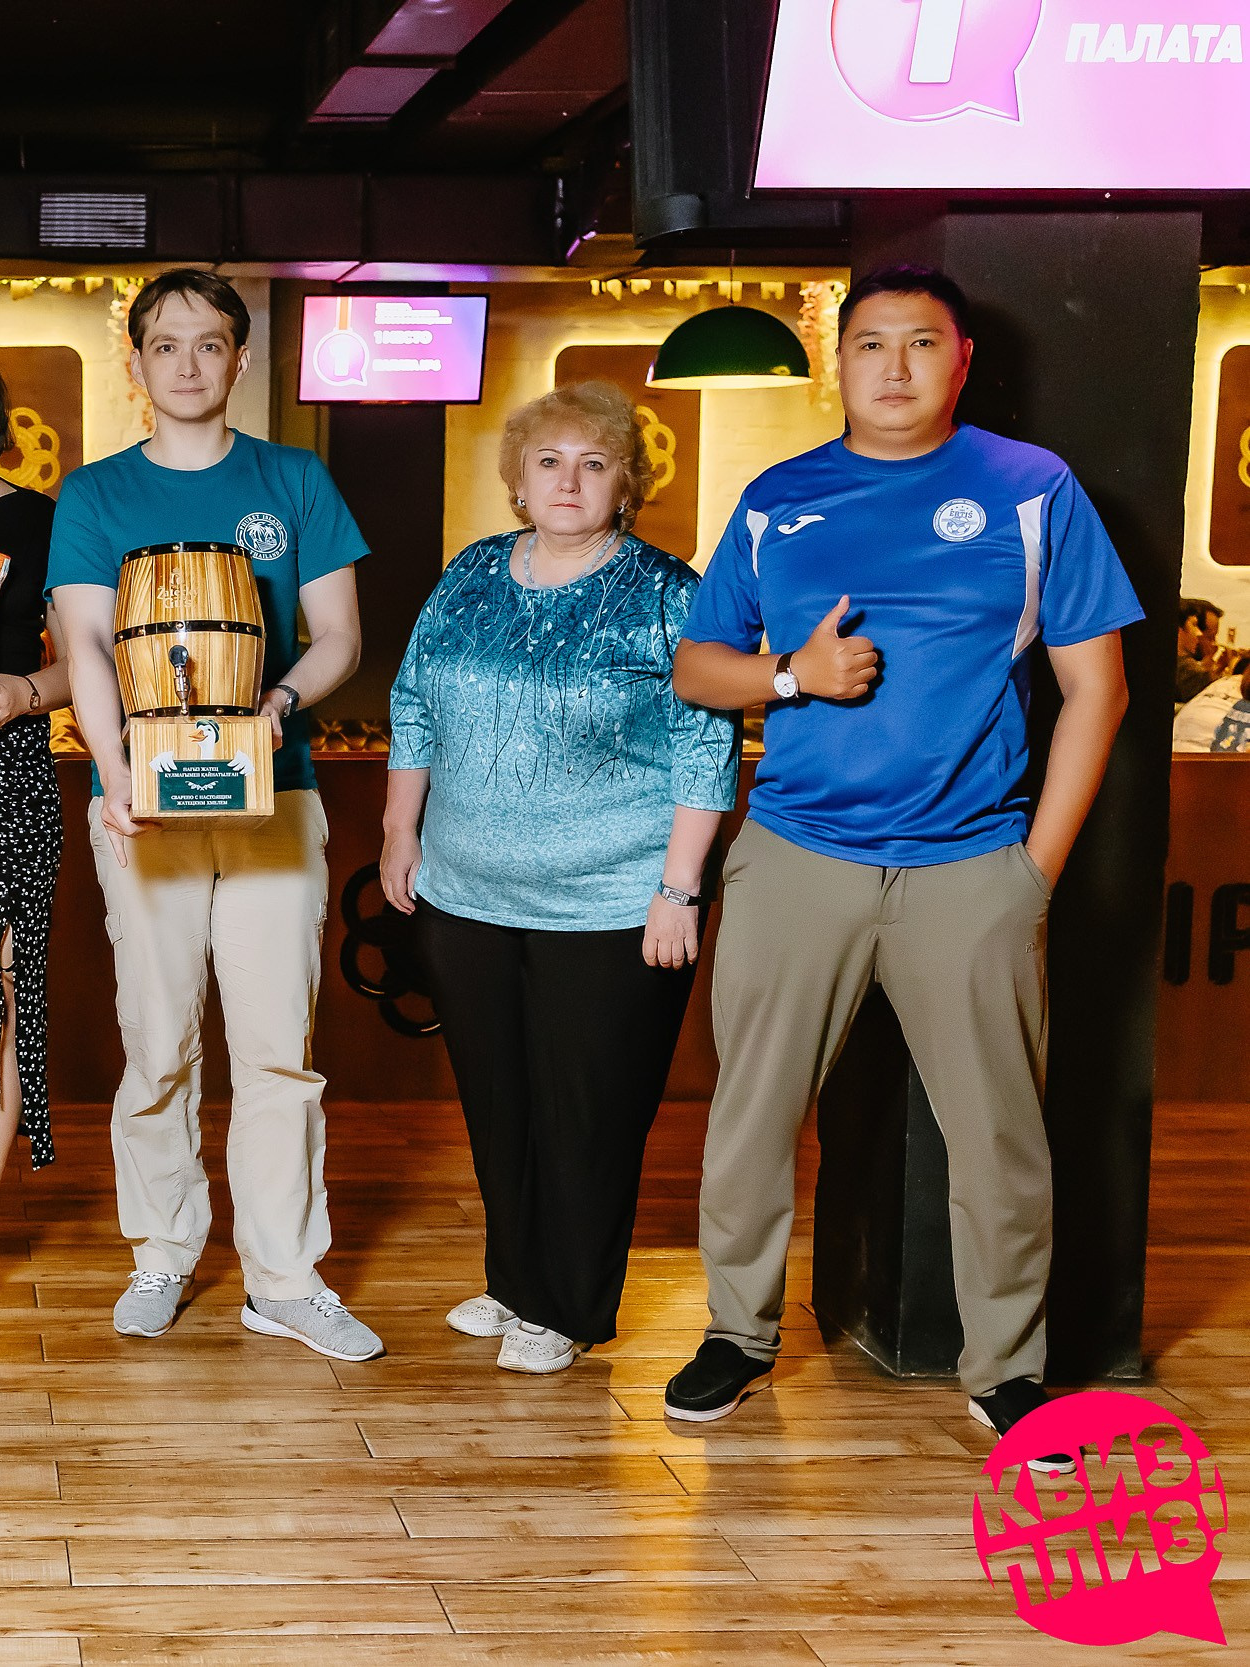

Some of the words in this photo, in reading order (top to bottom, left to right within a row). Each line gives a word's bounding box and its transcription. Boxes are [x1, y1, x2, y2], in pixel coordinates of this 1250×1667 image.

[1065, 24, 1243, 63] ПАЛАТА
[240, 514, 260, 530] PHUKET
[262, 514, 283, 530] ISLAND
[250, 549, 281, 559] THAILAND
